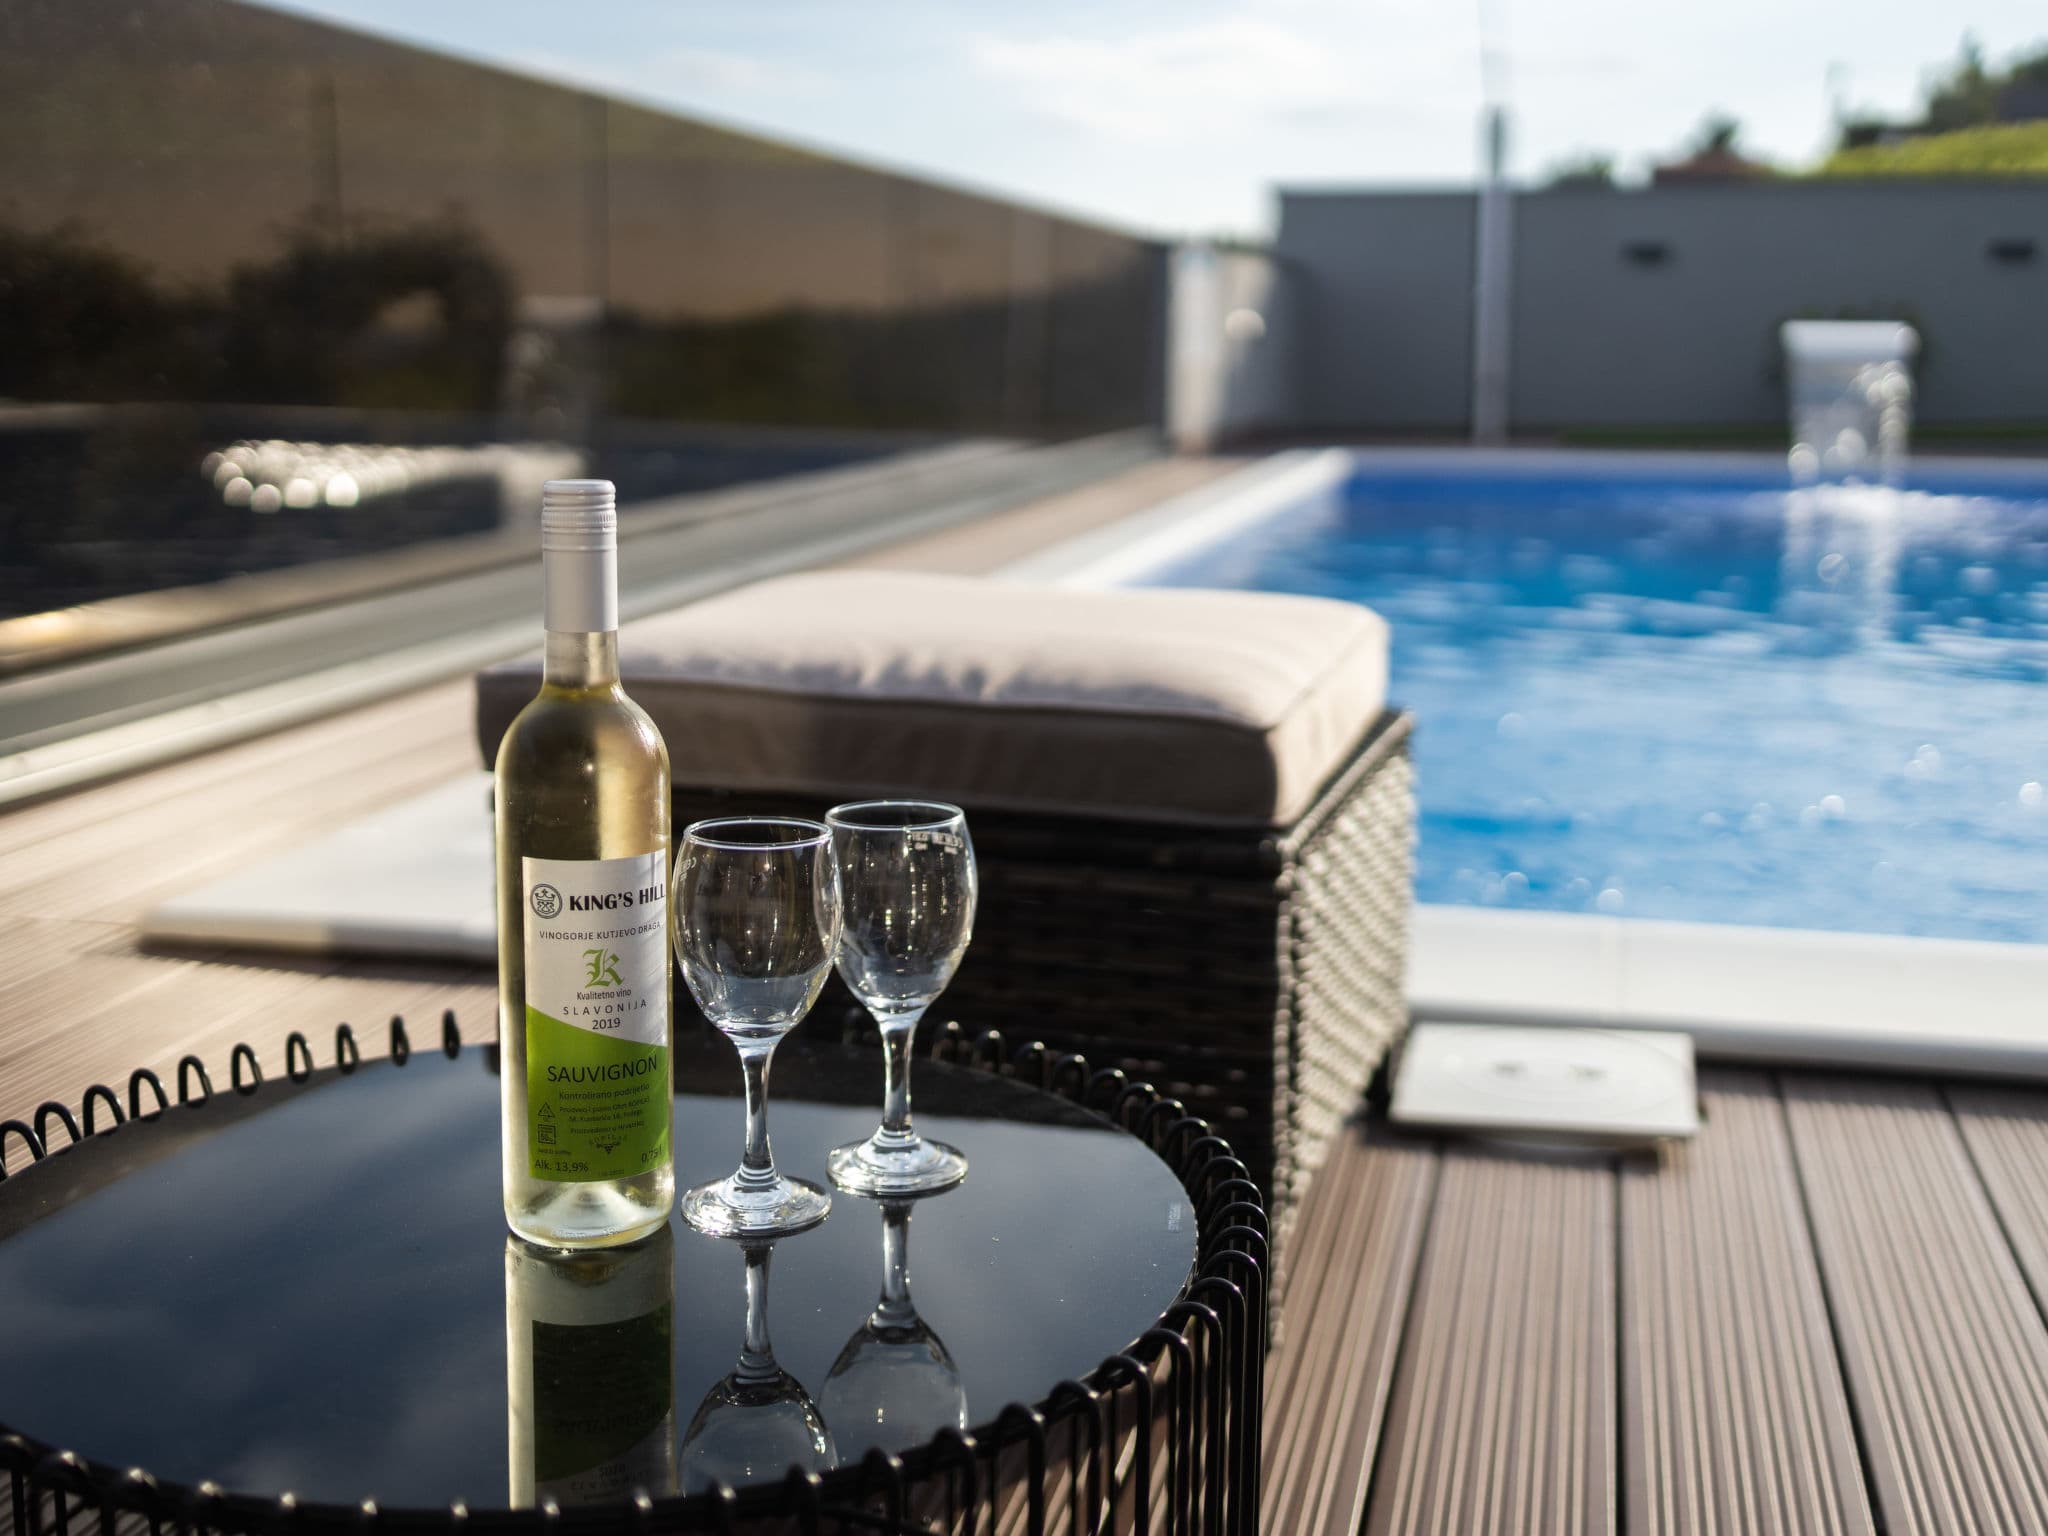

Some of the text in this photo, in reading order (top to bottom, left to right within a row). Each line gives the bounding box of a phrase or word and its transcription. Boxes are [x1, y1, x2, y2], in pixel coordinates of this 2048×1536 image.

[570, 884, 665, 911] KING'S HILL
[539, 930, 593, 940] VINOGORJE
[597, 928, 635, 939] KUTJEVO
[577, 989, 631, 1000] Kvalitetno vino
[592, 1018, 620, 1029] 2019
[548, 1055, 657, 1082] SAUVIGNON
[535, 1159, 552, 1170] Alk.
[556, 1162, 589, 1173] 13,9%
